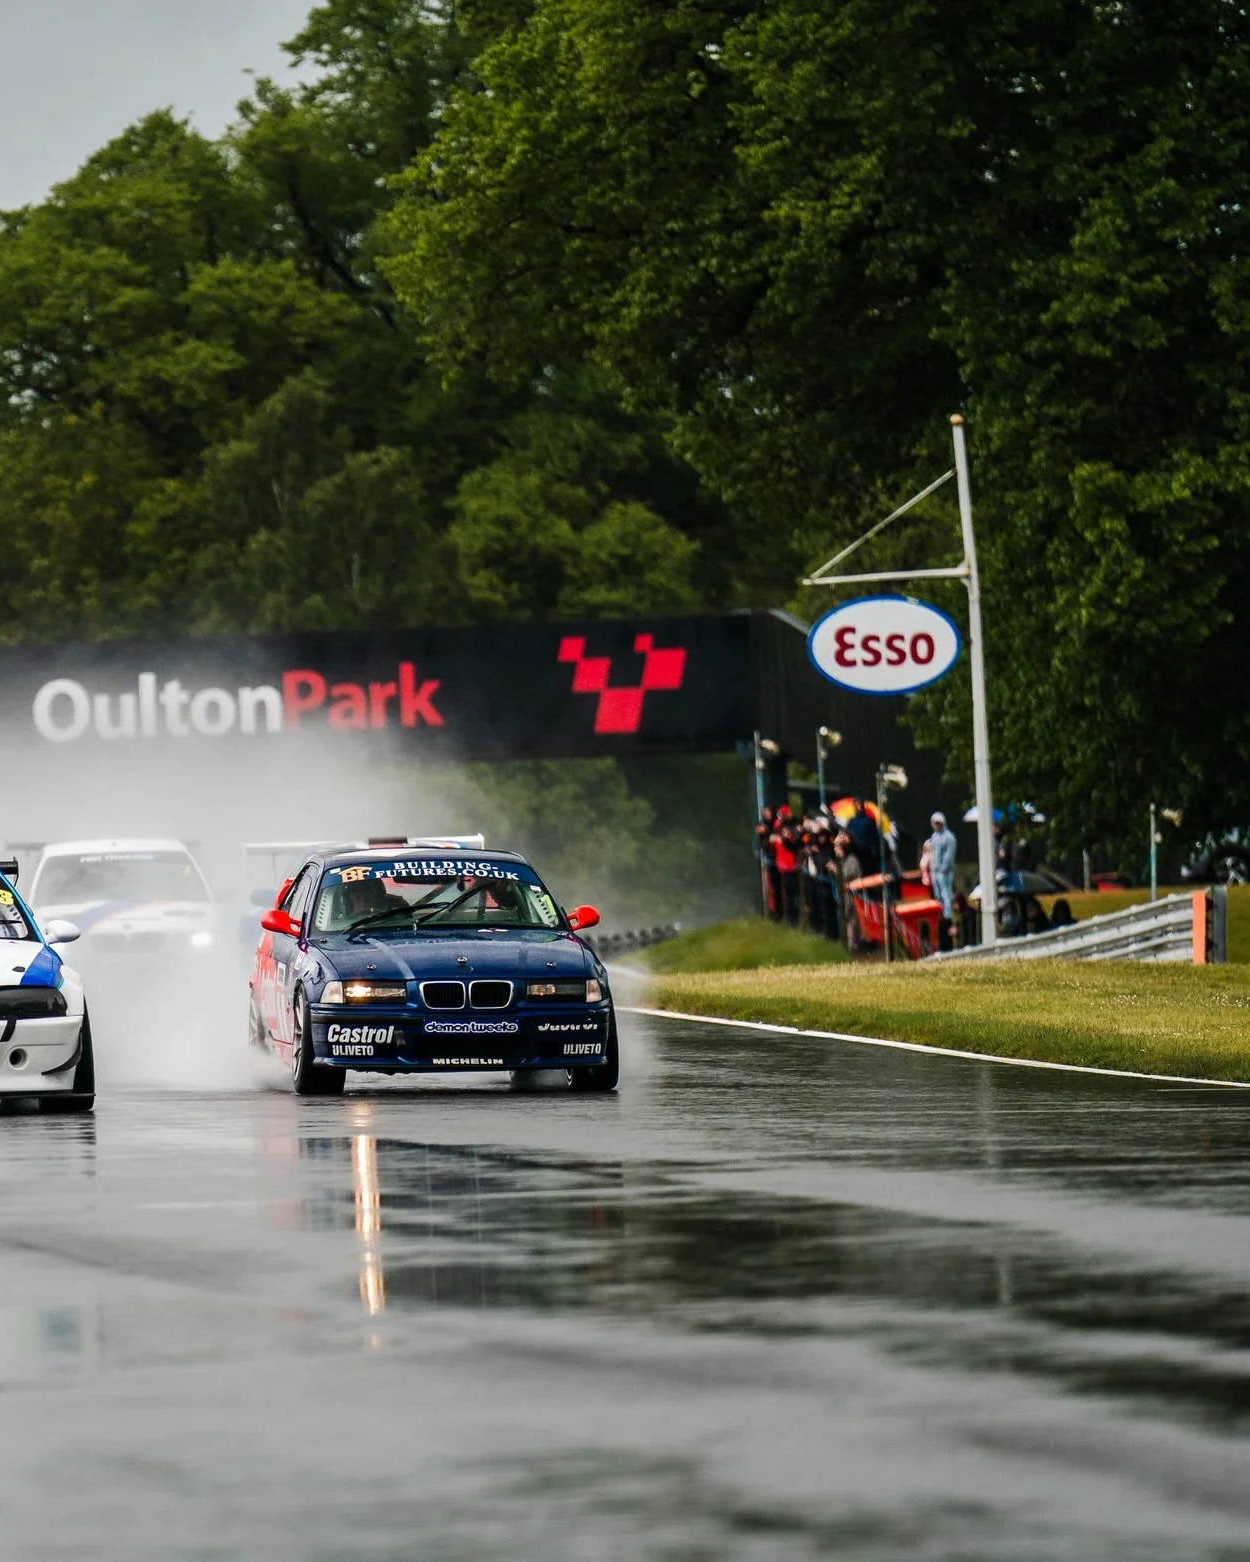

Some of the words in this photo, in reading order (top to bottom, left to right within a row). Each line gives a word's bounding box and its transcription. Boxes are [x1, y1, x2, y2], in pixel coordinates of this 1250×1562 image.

[375, 868, 519, 881] FUTURES.CO.UK
[424, 1021, 470, 1033] demon
[469, 1021, 519, 1033] tweeks
[327, 1024, 395, 1044] Castrol
[332, 1045, 374, 1056] ULIVETO
[563, 1043, 602, 1055] ULIVETO
